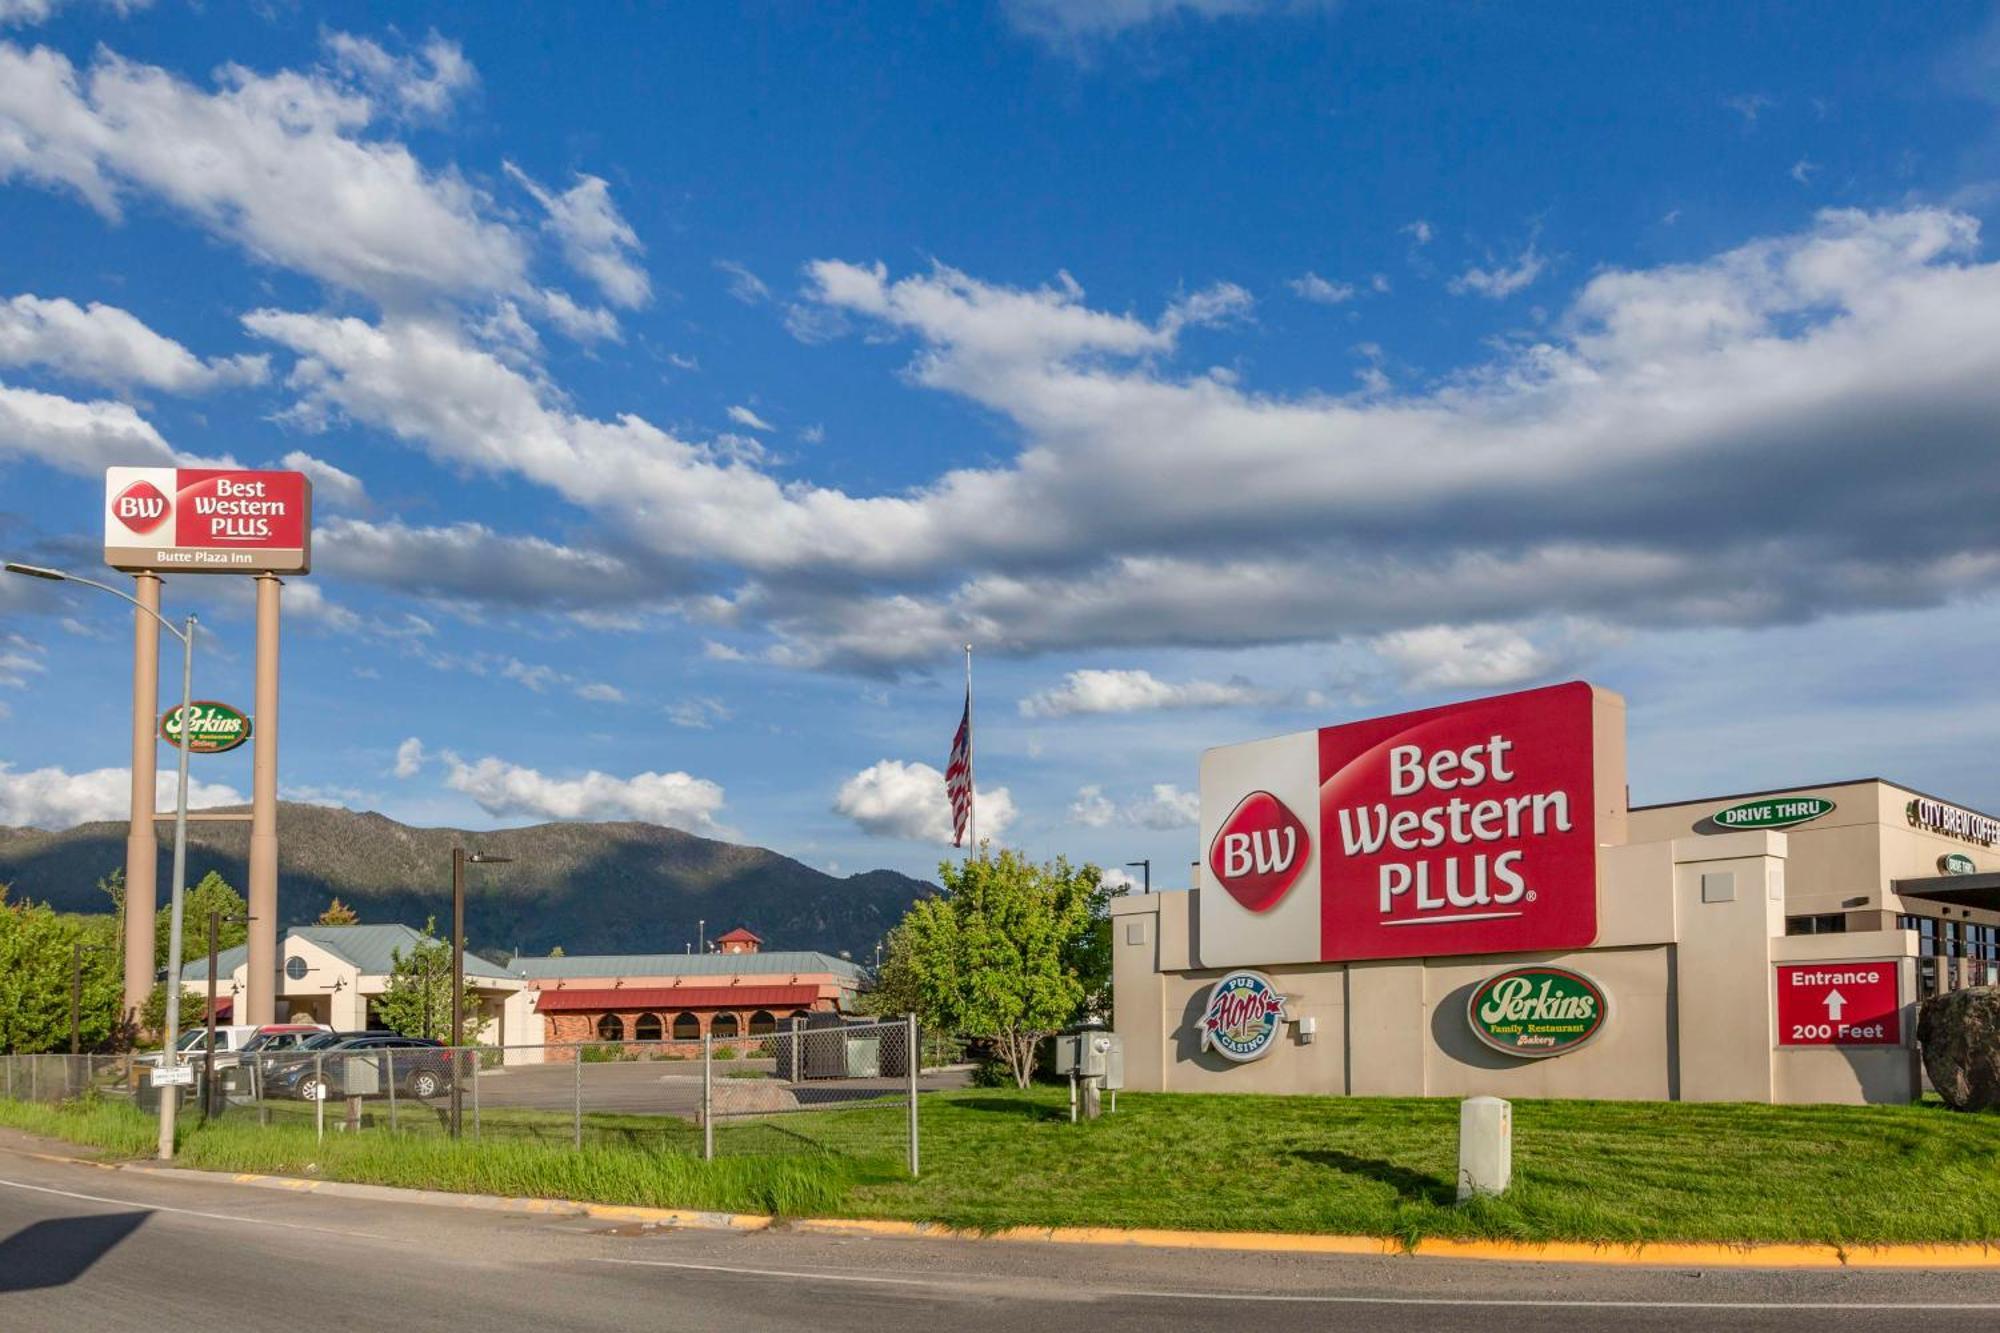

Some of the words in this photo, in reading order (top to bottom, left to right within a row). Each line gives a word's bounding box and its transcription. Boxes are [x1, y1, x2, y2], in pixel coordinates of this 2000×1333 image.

[217, 479, 265, 497] Best
[120, 497, 163, 518] BW
[195, 497, 285, 515] Western
[157, 551, 192, 562] Butte
[195, 552, 228, 563] Plaza
[231, 554, 253, 563] Inn
[1389, 735, 1515, 796] Best
[1726, 806, 1772, 823] DRIVE
[1775, 800, 1820, 818] THRU
[1919, 799, 1941, 828] CITY
[1943, 807, 1970, 836] BREW
[1338, 790, 1572, 857] Western
[1224, 826, 1296, 878] BW
[1229, 978, 1254, 990] PUB
[1791, 971, 1880, 986] Entrance
[1480, 977, 1596, 1024] Perkins
[1490, 1024, 1523, 1034] Family
[1527, 1024, 1585, 1033] Restaurant
[1792, 1024, 1832, 1039] 200
[1838, 1023, 1884, 1038] Feet
[1221, 1034, 1266, 1053] CASINO
[1517, 1034, 1556, 1046] Bakery
